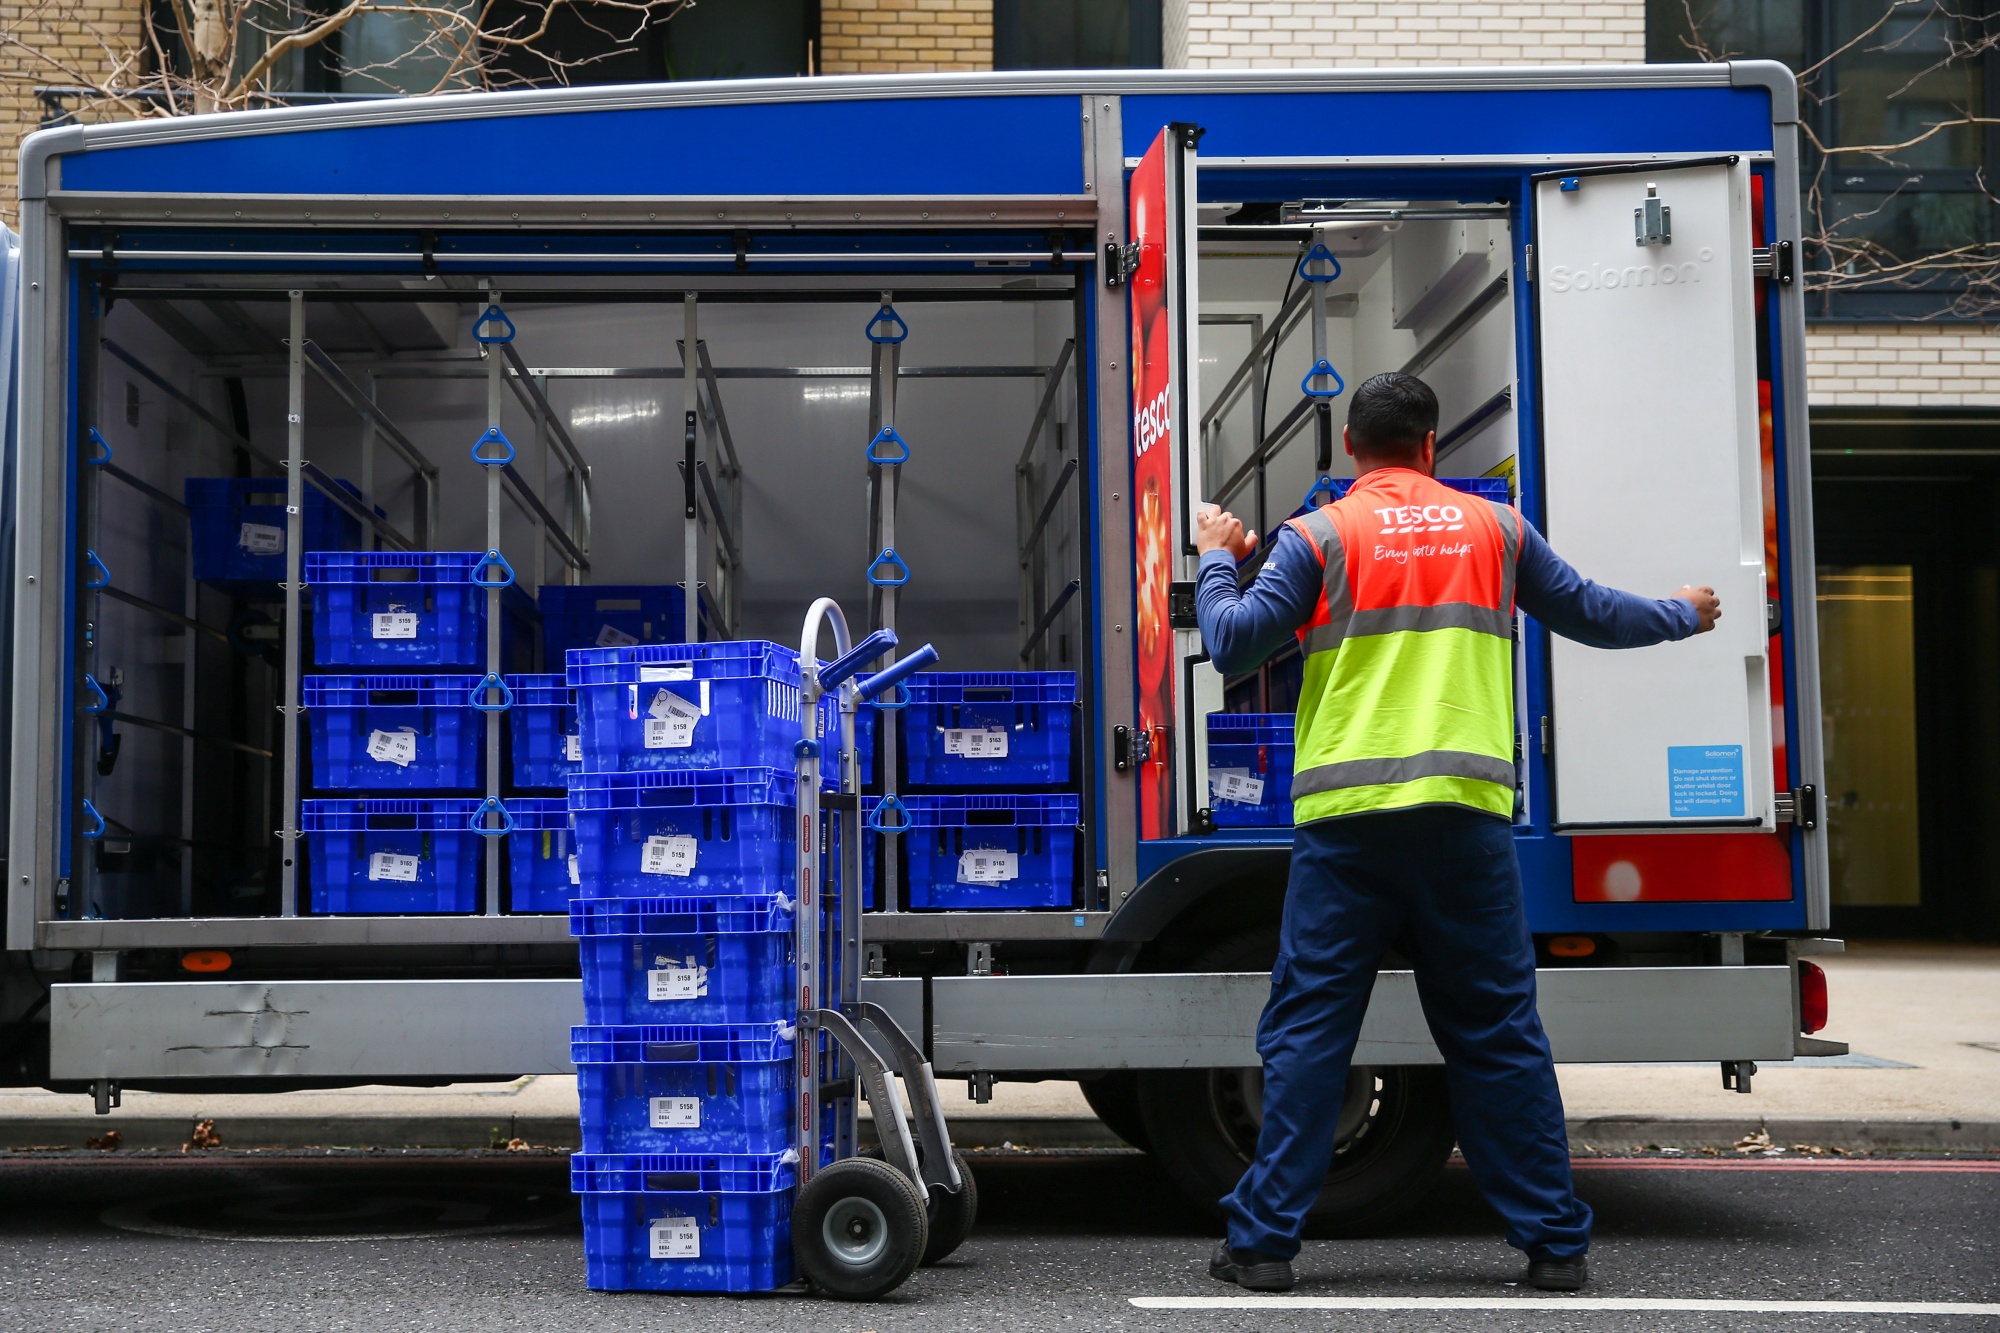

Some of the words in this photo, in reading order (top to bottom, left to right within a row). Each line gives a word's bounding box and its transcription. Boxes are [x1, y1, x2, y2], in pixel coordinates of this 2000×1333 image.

[1549, 262, 1700, 293] Solomon
[1374, 506, 1463, 525] TESCO
[1374, 545, 1408, 564] Every
[1440, 542, 1473, 557] helps
